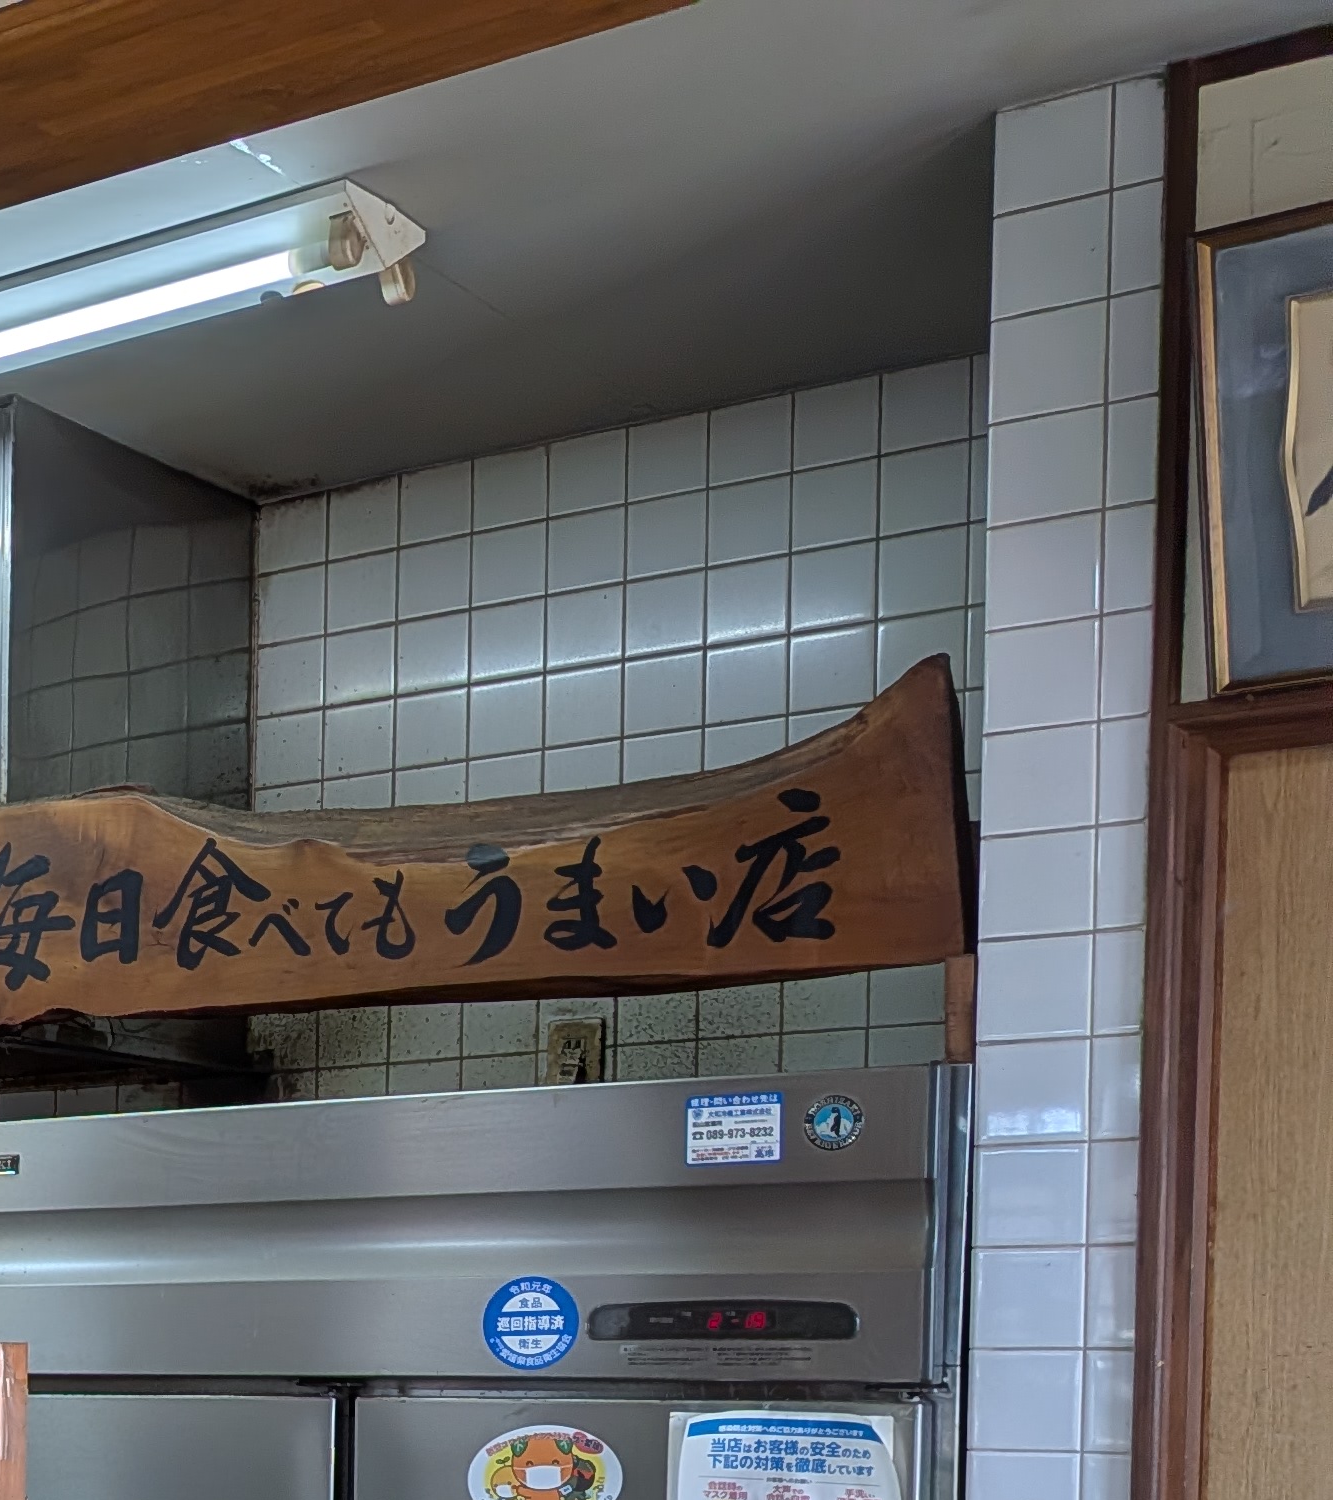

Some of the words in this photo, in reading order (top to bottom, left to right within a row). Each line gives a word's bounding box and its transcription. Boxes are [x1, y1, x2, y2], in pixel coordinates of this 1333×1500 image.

[509, 1281, 553, 1294] 令和元年
[518, 1297, 543, 1308] 食品
[496, 1315, 564, 1332] 巡回指導済
[706, 1311, 723, 1331] 2
[518, 1338, 543, 1349] 衛生
[710, 1438, 872, 1460] 当店はお客様の安全のため
[707, 1454, 874, 1476] 下記の対策を徹底しています
